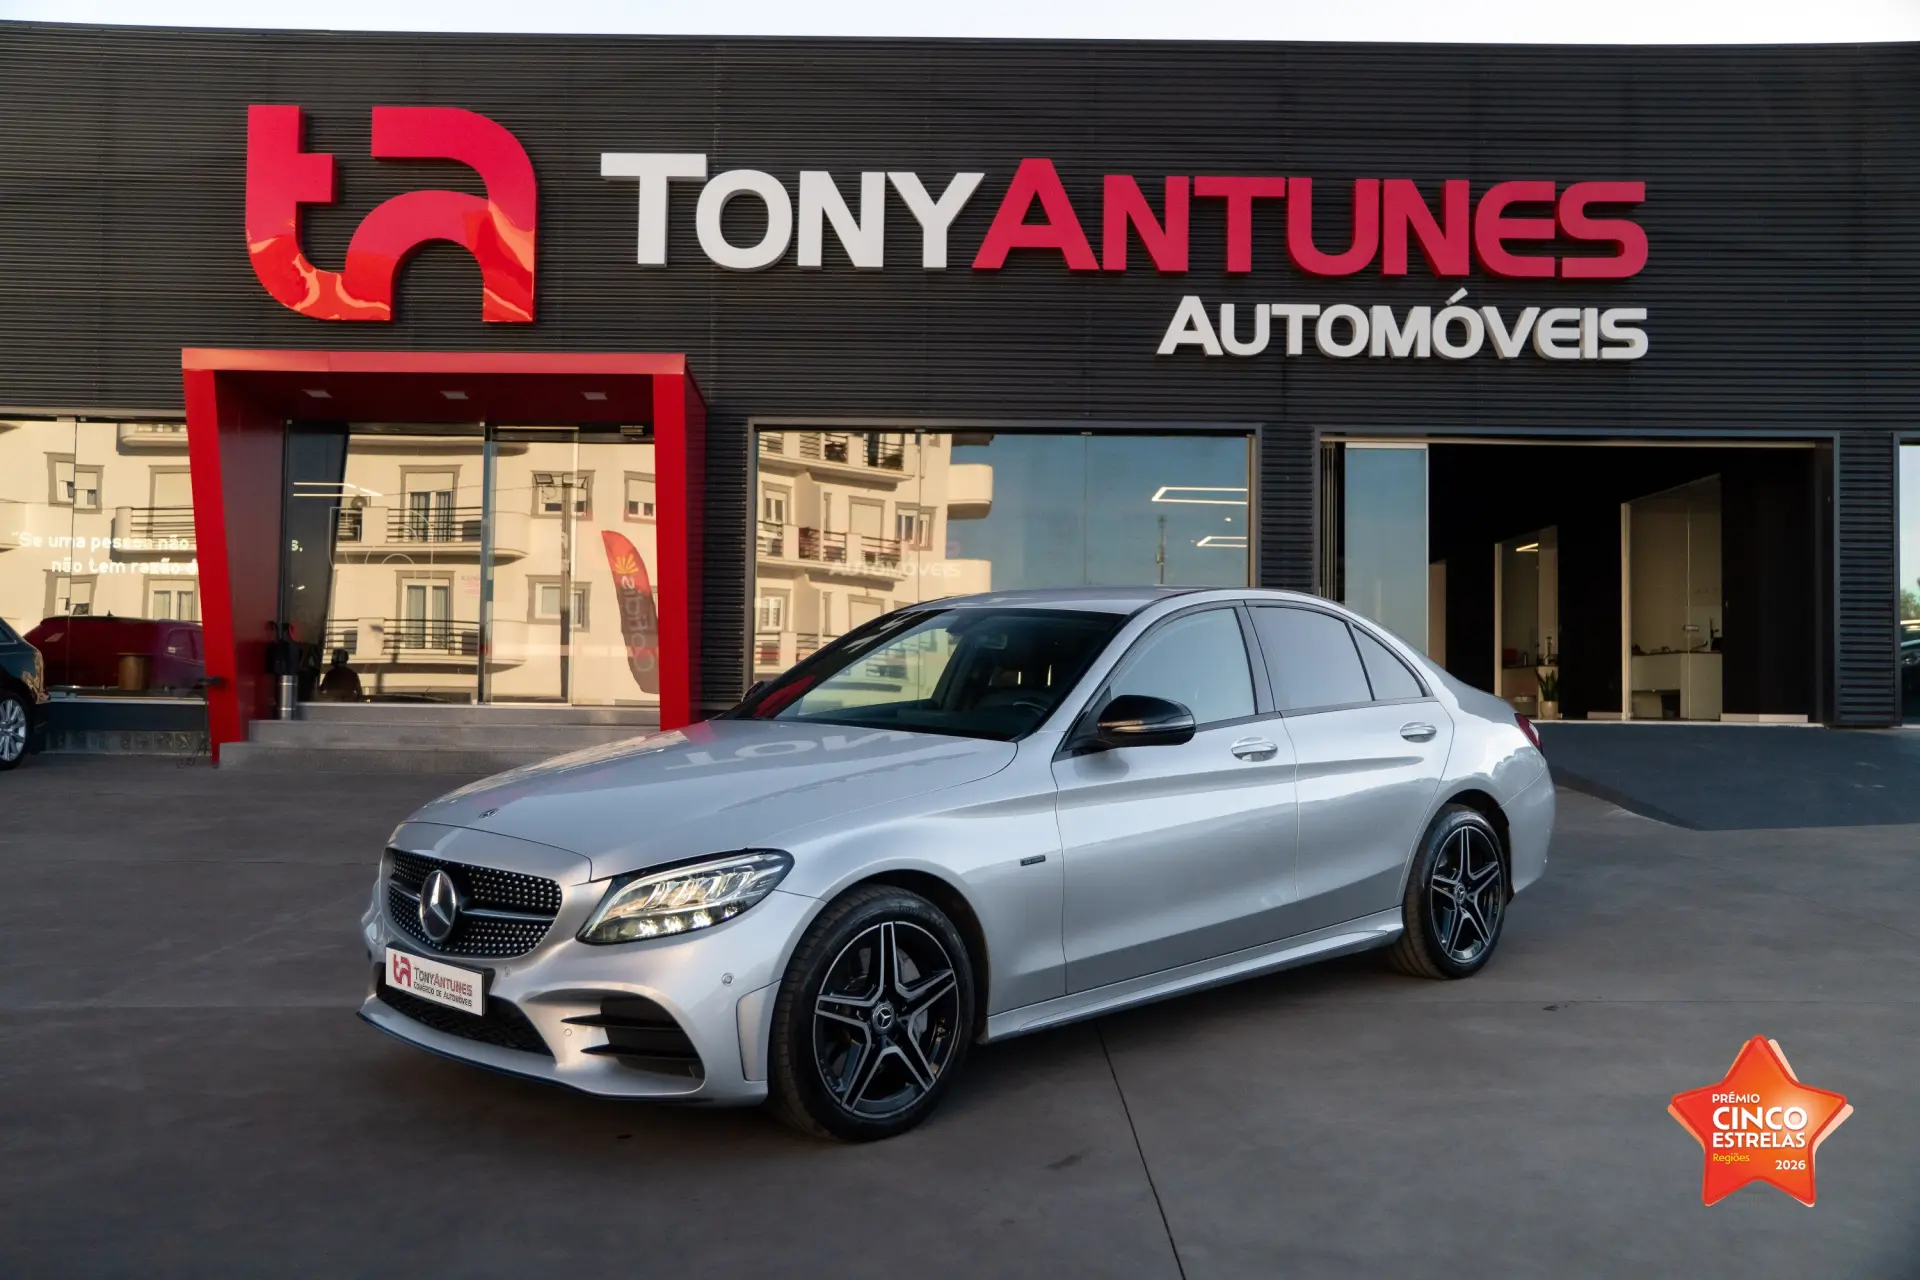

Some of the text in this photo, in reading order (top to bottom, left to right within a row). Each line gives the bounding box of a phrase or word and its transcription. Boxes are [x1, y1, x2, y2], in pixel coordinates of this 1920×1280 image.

[1156, 287, 1650, 361] AUTOMÓVEIS
[48, 537, 86, 549] uma
[51, 557, 83, 573] não
[88, 557, 126, 574] tem
